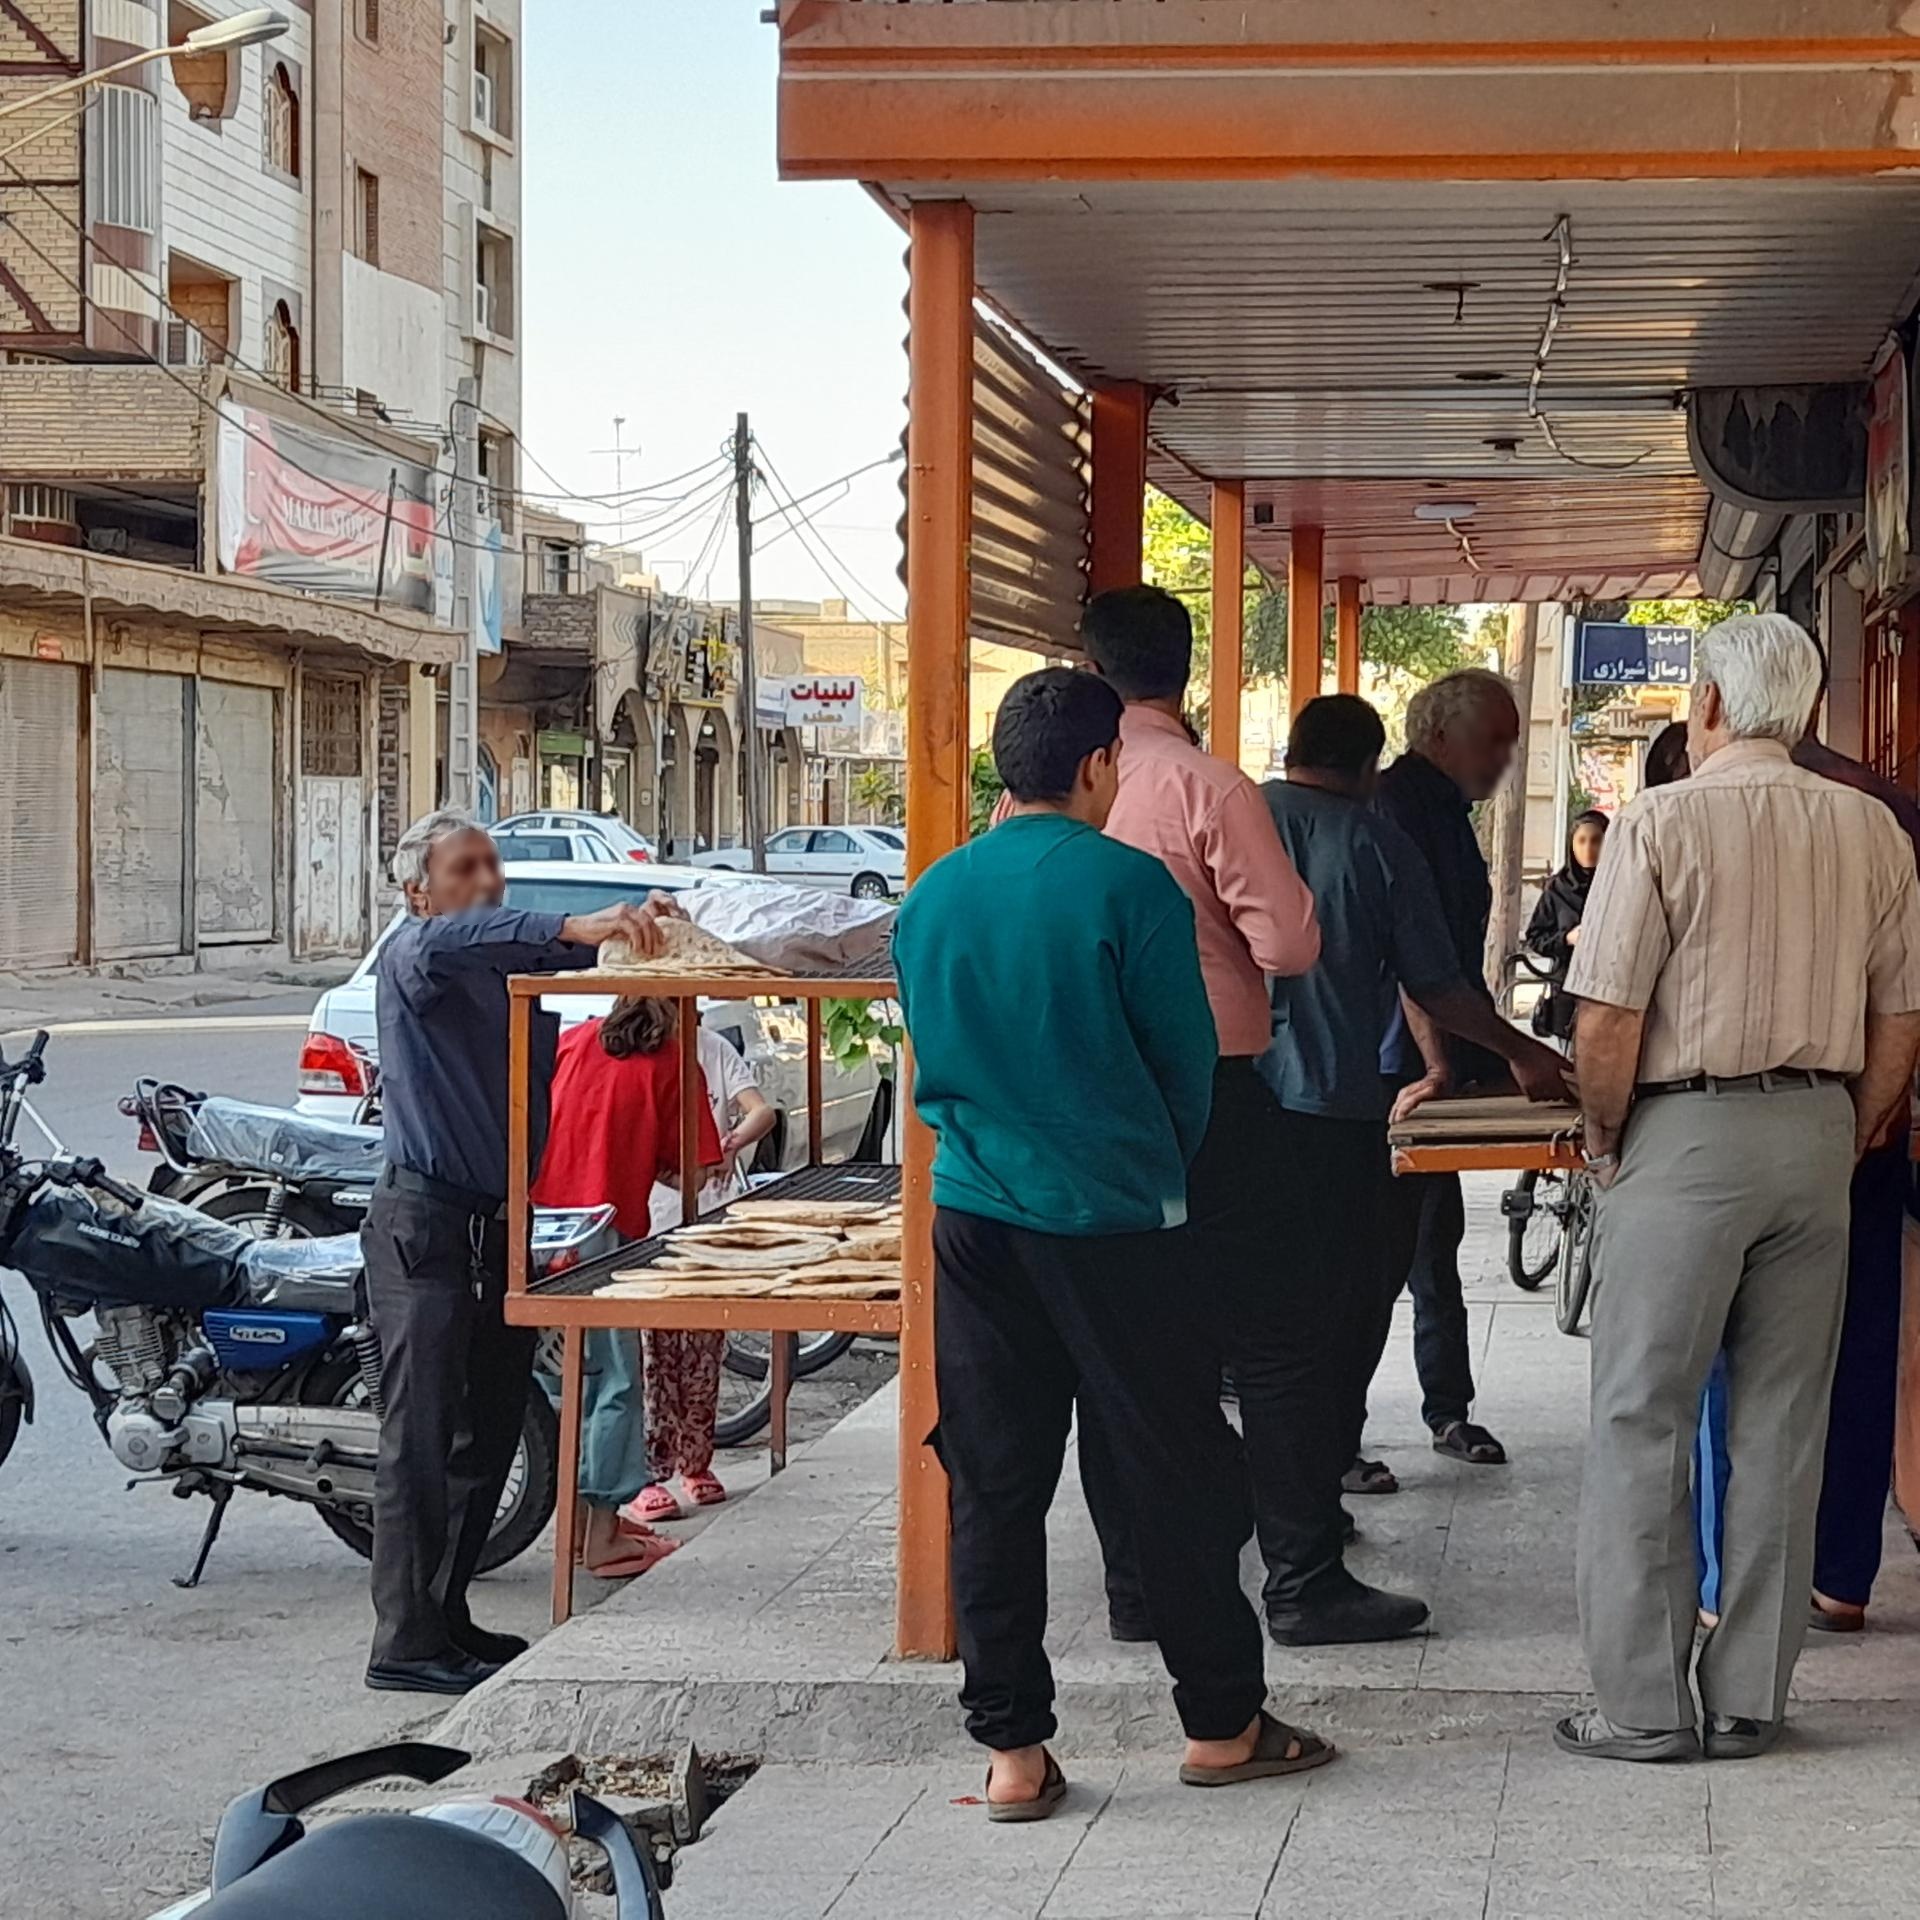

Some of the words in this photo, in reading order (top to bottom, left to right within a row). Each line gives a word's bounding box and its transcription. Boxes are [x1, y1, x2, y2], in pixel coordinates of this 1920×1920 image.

[1647, 631, 1688, 645] خیابان
[1593, 658, 1646, 680] شیرازی
[1647, 659, 1688, 681] وصال
[790, 680, 855, 708] لبنیات
